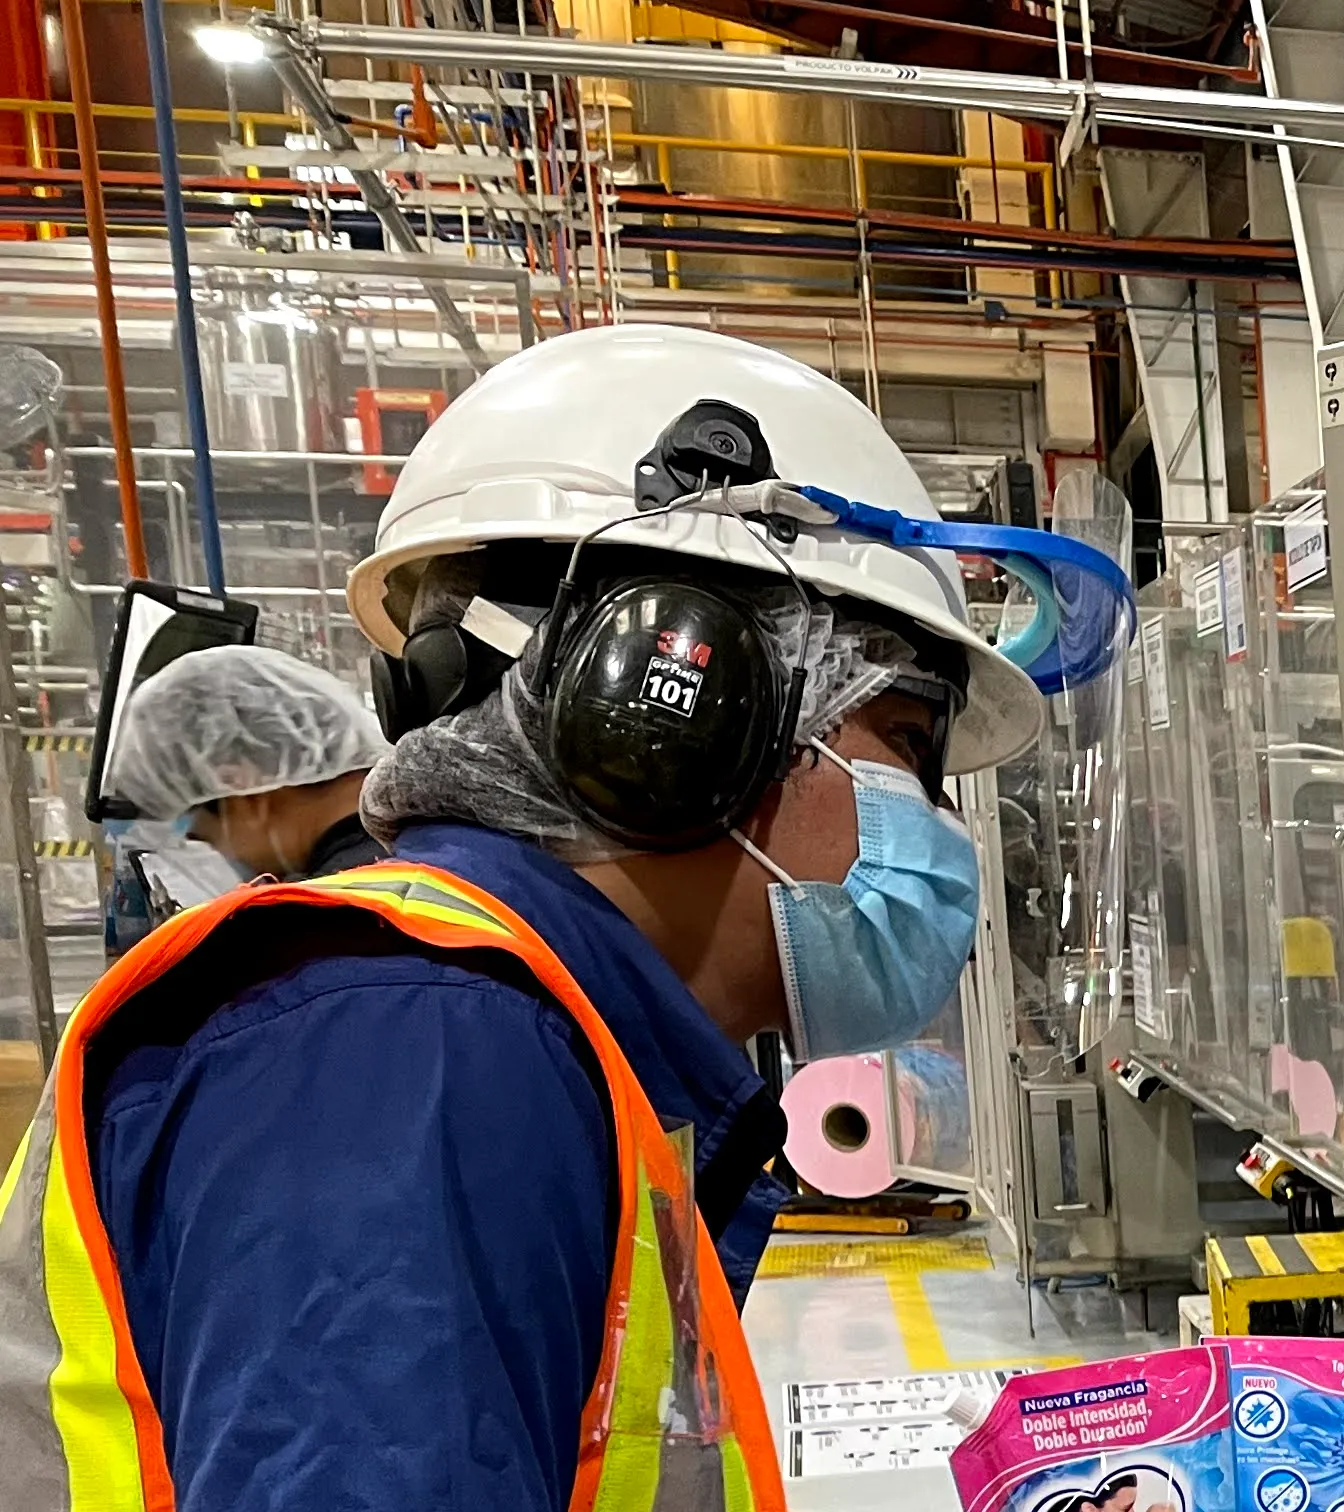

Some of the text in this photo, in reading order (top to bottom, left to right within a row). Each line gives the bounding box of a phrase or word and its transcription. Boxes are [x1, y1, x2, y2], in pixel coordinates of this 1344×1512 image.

[795, 60, 851, 72] PRODUCTO
[657, 630, 712, 668] 3M
[648, 675, 695, 710] 101
[1024, 1382, 1146, 1412] Nueva Fragancia
[1245, 1378, 1276, 1389] NUEVO
[1022, 1398, 1153, 1435] Doble Intensidad,
[1032, 1430, 1078, 1451] Doble
